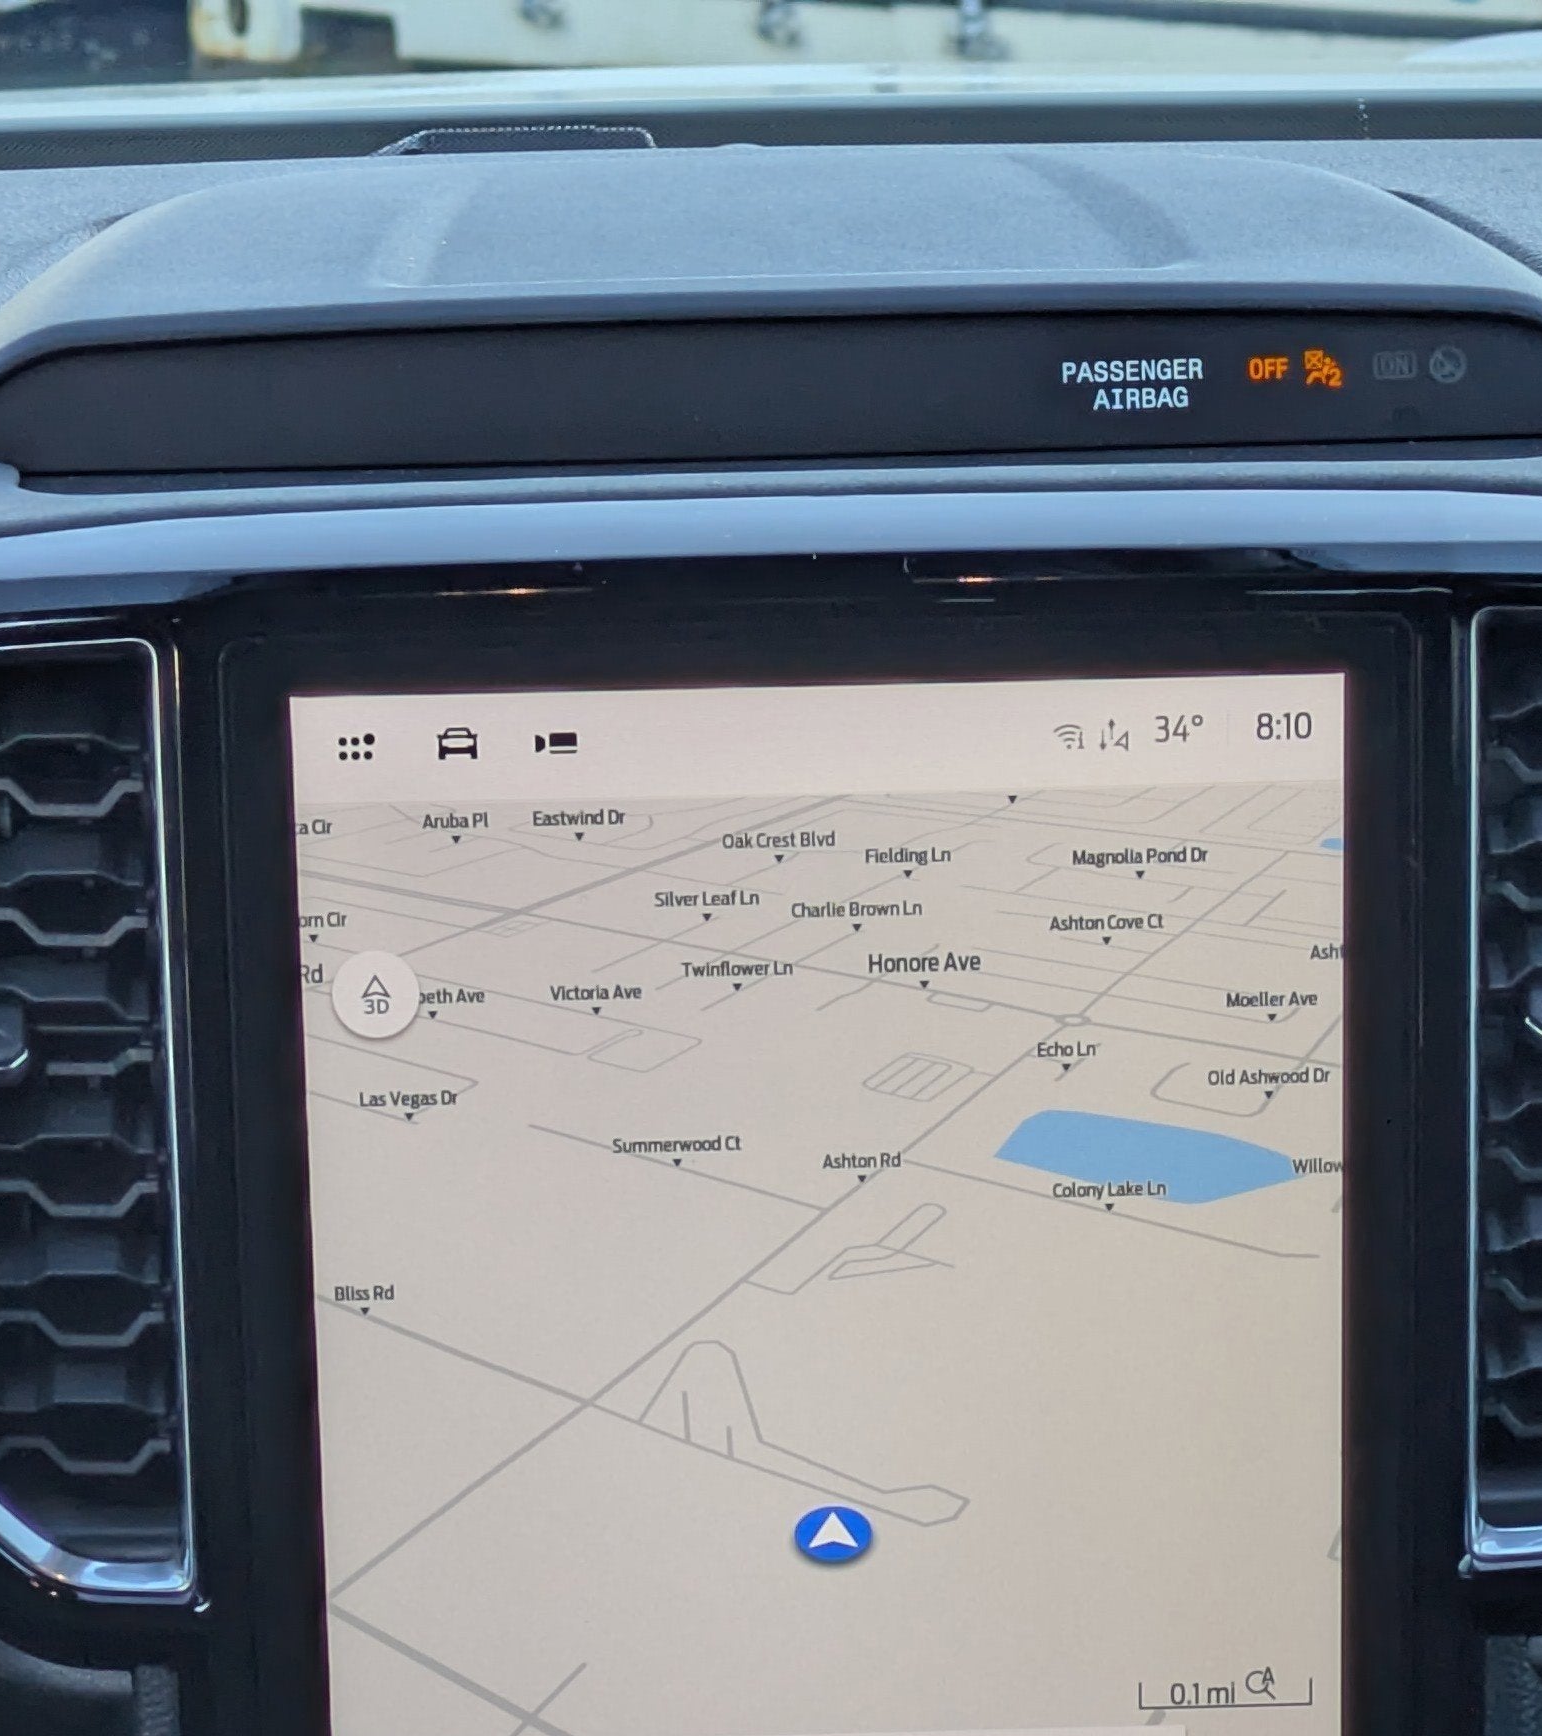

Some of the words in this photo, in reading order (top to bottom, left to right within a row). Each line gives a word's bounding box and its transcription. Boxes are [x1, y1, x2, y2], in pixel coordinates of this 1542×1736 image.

[1061, 357, 1203, 383] PASSENGER
[1248, 356, 1289, 380] OFF
[1092, 386, 1188, 410] AIRBAG
[1154, 714, 1204, 744] 34°
[1256, 712, 1313, 741] 8:10
[295, 823, 309, 835] a
[311, 818, 332, 835] Cir
[422, 813, 469, 829] Aruba
[472, 812, 489, 828] Pl
[532, 810, 605, 827] Eastwind
[608, 809, 626, 825] Dr
[722, 834, 753, 849] Oak
[756, 833, 796, 849] Crest
[799, 832, 836, 848] Blvd
[865, 847, 927, 866] Fielding
[931, 848, 951, 864] Ln
[1072, 848, 1143, 867] Magnolia
[1147, 848, 1185, 864] Pond
[1188, 847, 1208, 863] Dr
[654, 891, 700, 907] Silver
[702, 891, 737, 907] Leaf
[739, 891, 760, 906] Ln
[791, 901, 845, 918] Charlie
[849, 901, 899, 917] Brown
[903, 901, 923, 916] Ln
[326, 911, 348, 928] Cir
[1049, 914, 1105, 931] Ashton
[1109, 914, 1145, 930] Cove
[1147, 914, 1164, 929] Ct
[681, 961, 769, 978] Twinflower
[773, 961, 794, 976] Ln
[868, 953, 939, 974] Honore
[943, 952, 981, 972] Ave
[456, 988, 485, 1003] Ave
[550, 985, 609, 1001] Victoria
[613, 984, 642, 1000] Ave
[1226, 991, 1285, 1008] Moeller
[1288, 990, 1318, 1006] Ave
[363, 999, 390, 1015] 3D
[1036, 1041, 1073, 1058] Echo
[1076, 1041, 1097, 1057] Ln
[1207, 1069, 1235, 1086] Old
[1239, 1068, 1309, 1085] Ashwood
[1312, 1067, 1330, 1083] Dr
[359, 1091, 386, 1107] Las
[389, 1091, 437, 1109] Vegas
[440, 1090, 458, 1106] Dr
[612, 1136, 721, 1154] Summerwood
[724, 1136, 741, 1152] Ct
[822, 1152, 876, 1169] Ashton
[879, 1151, 901, 1168] Rd
[1052, 1181, 1106, 1200] Colony
[1109, 1181, 1143, 1198] Lake
[1146, 1180, 1167, 1196] Ln
[334, 1285, 370, 1302] Bliss
[373, 1284, 395, 1301] Rd
[1170, 1682, 1200, 1705] 0.1
[1207, 1681, 1235, 1704] mi
